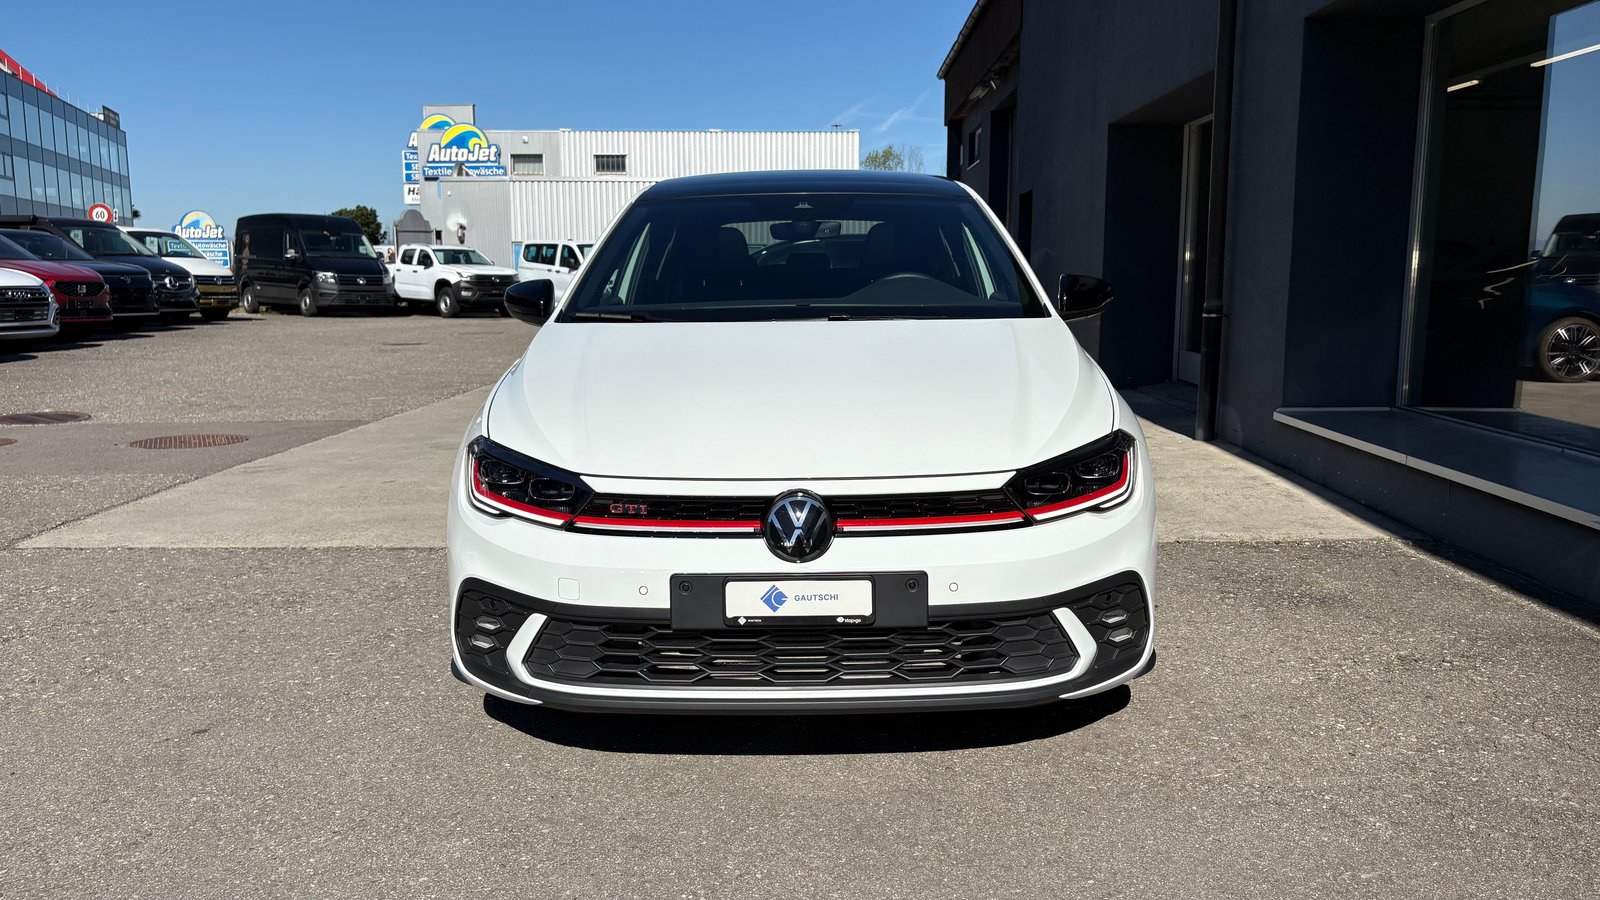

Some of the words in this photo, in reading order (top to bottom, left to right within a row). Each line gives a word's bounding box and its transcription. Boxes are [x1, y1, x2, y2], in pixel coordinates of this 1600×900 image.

[428, 144, 497, 162] AutoJet
[423, 167, 453, 176] Textile
[468, 167, 504, 176] owäsche
[95, 210, 105, 220] 60
[174, 225, 223, 239] AutoJet
[609, 502, 648, 515] GTI
[794, 593, 839, 602] GAUTSCHI
